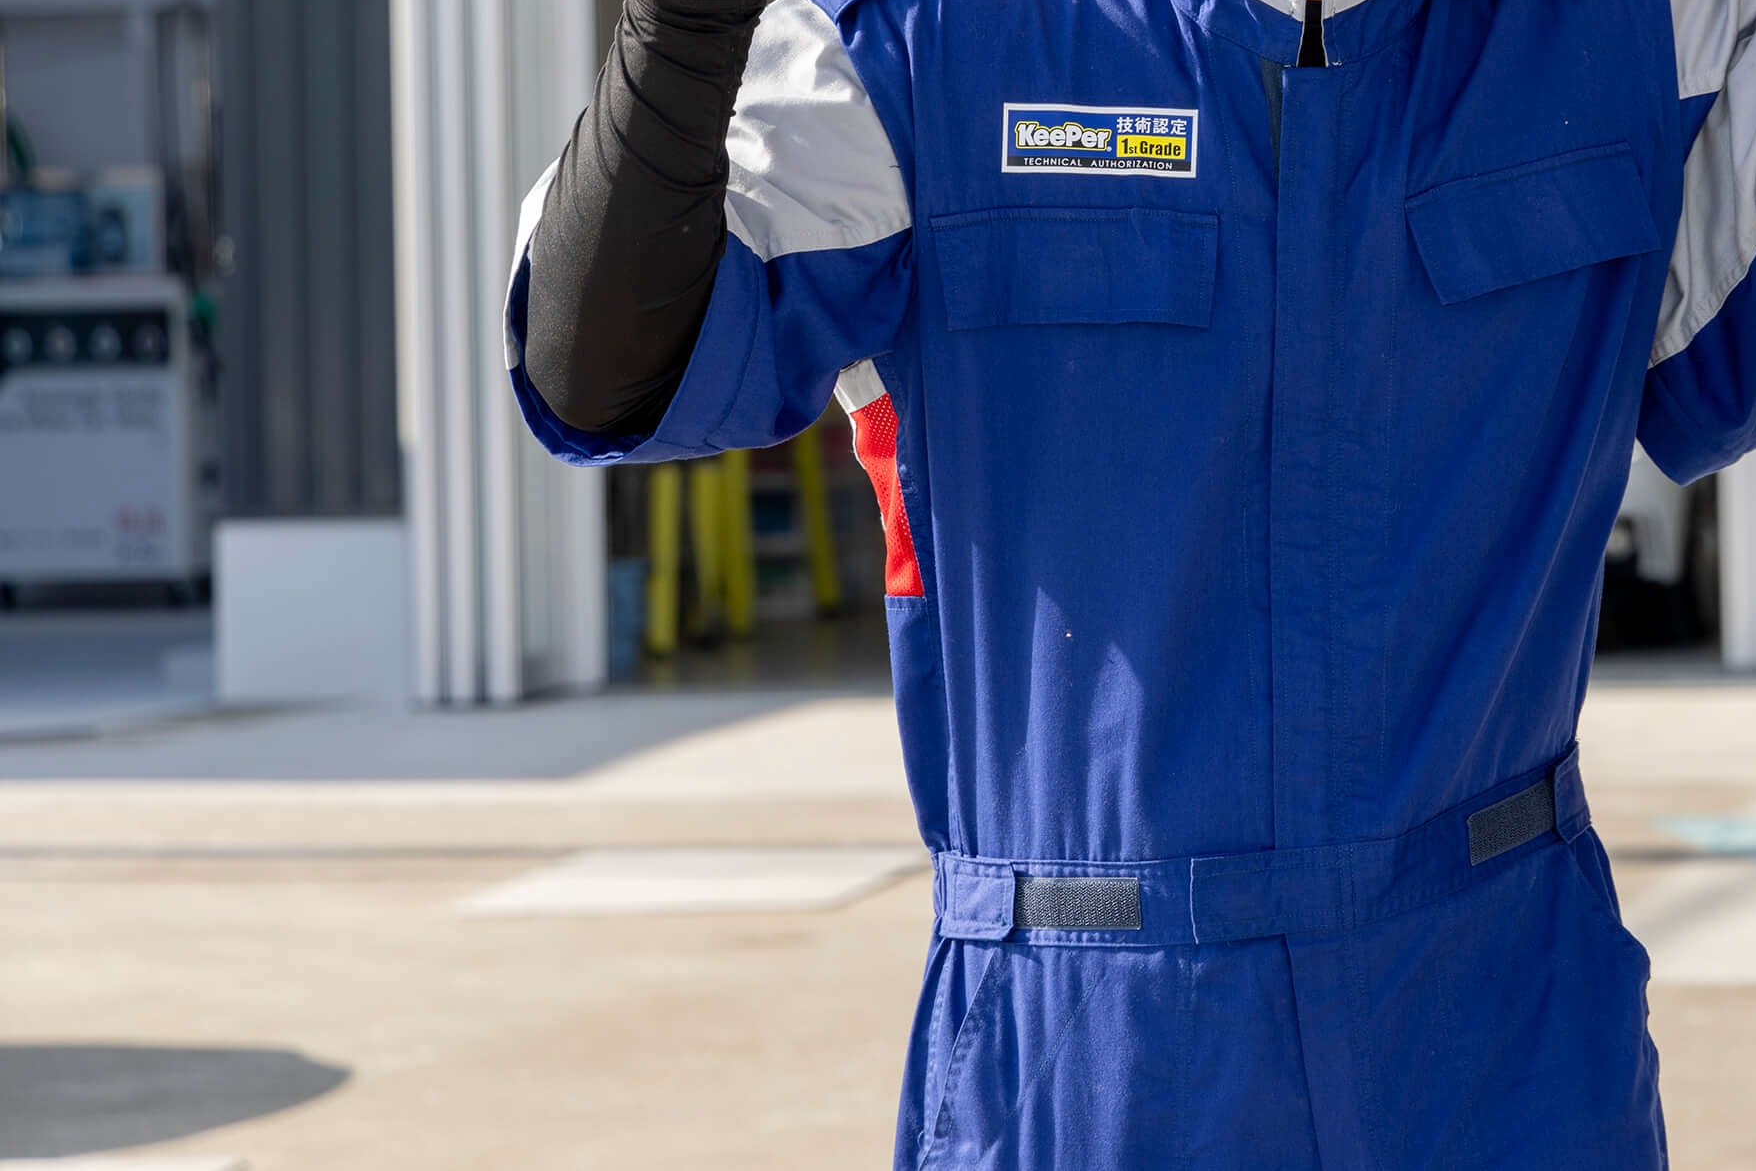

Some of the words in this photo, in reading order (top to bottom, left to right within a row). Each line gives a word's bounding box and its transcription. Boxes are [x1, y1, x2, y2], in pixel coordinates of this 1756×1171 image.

[1117, 116, 1187, 135] 技術認定
[1015, 122, 1111, 149] KeePer
[1024, 157, 1082, 167] TECHNICAL
[1091, 159, 1173, 170] AUTHORIZATION
